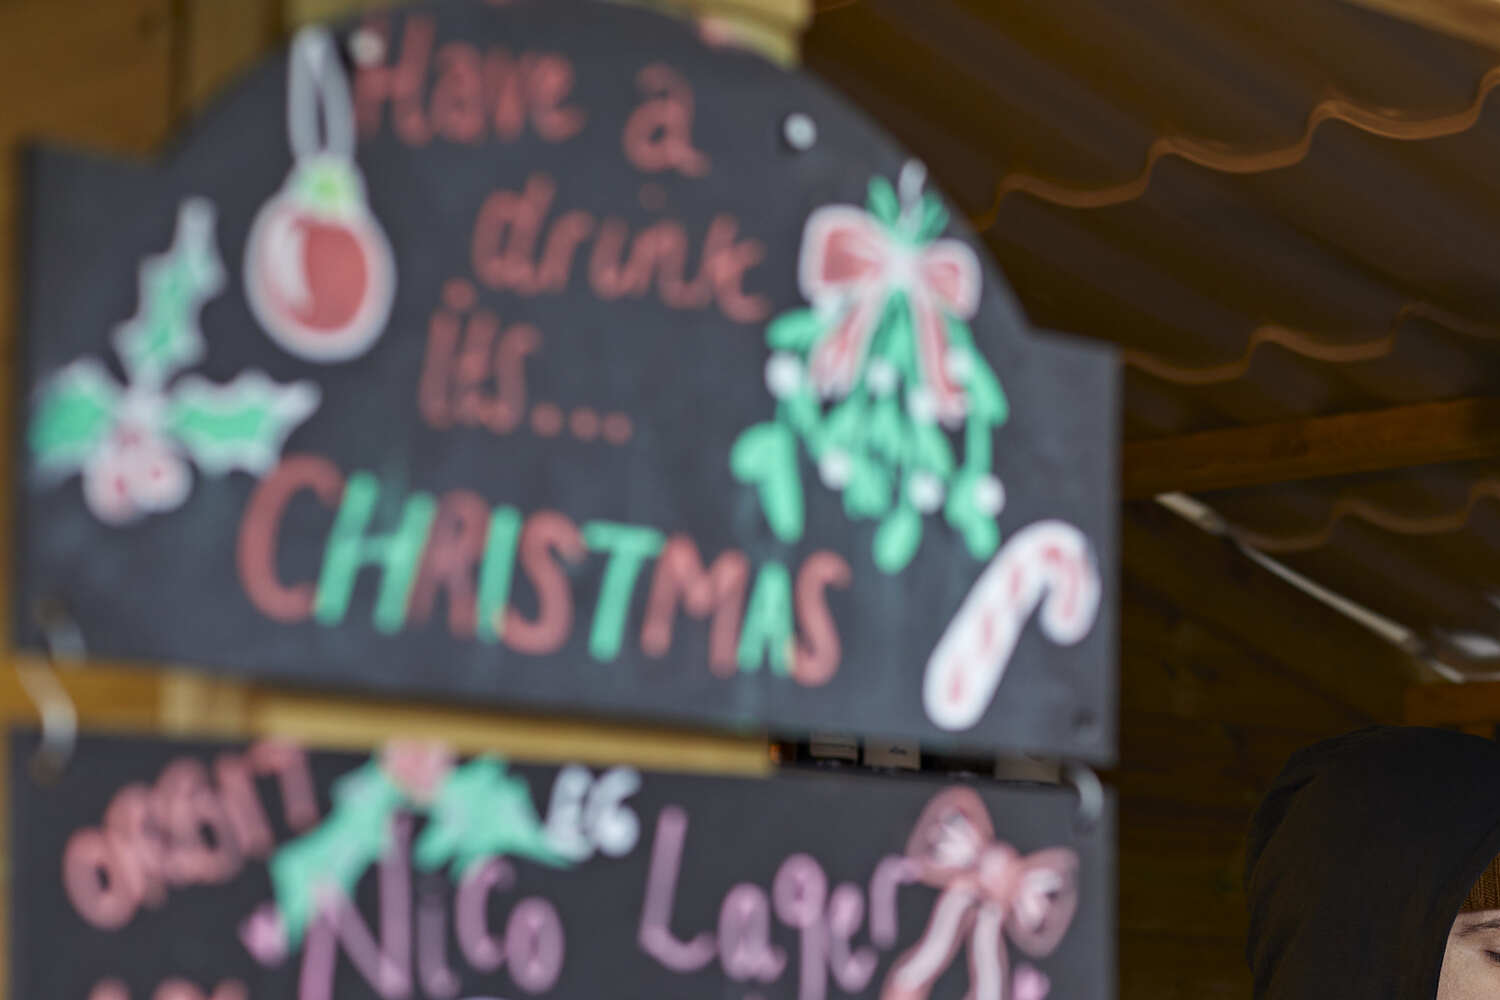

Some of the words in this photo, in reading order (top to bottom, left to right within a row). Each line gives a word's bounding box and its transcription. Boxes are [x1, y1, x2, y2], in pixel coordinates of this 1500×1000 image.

[352, 12, 587, 145] Have
[622, 62, 711, 177] a
[471, 170, 769, 323] drink
[237, 452, 851, 687] CHRISTMAS
